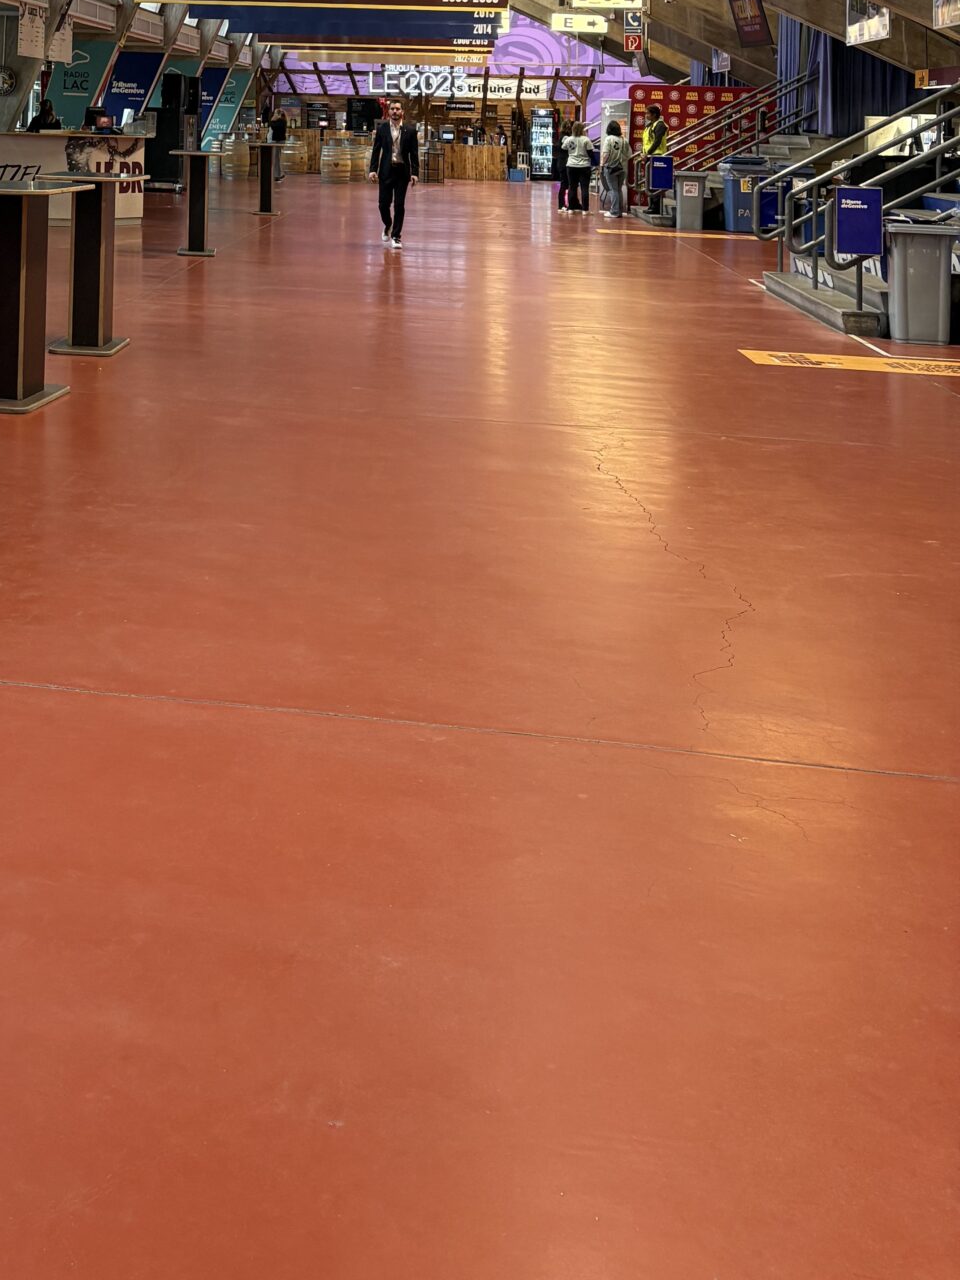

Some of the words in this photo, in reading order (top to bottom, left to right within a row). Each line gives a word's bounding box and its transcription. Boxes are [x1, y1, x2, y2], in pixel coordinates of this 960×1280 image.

[564, 18, 573, 28] E
[63, 80, 89, 90] LAC
[468, 84, 512, 93] triune
